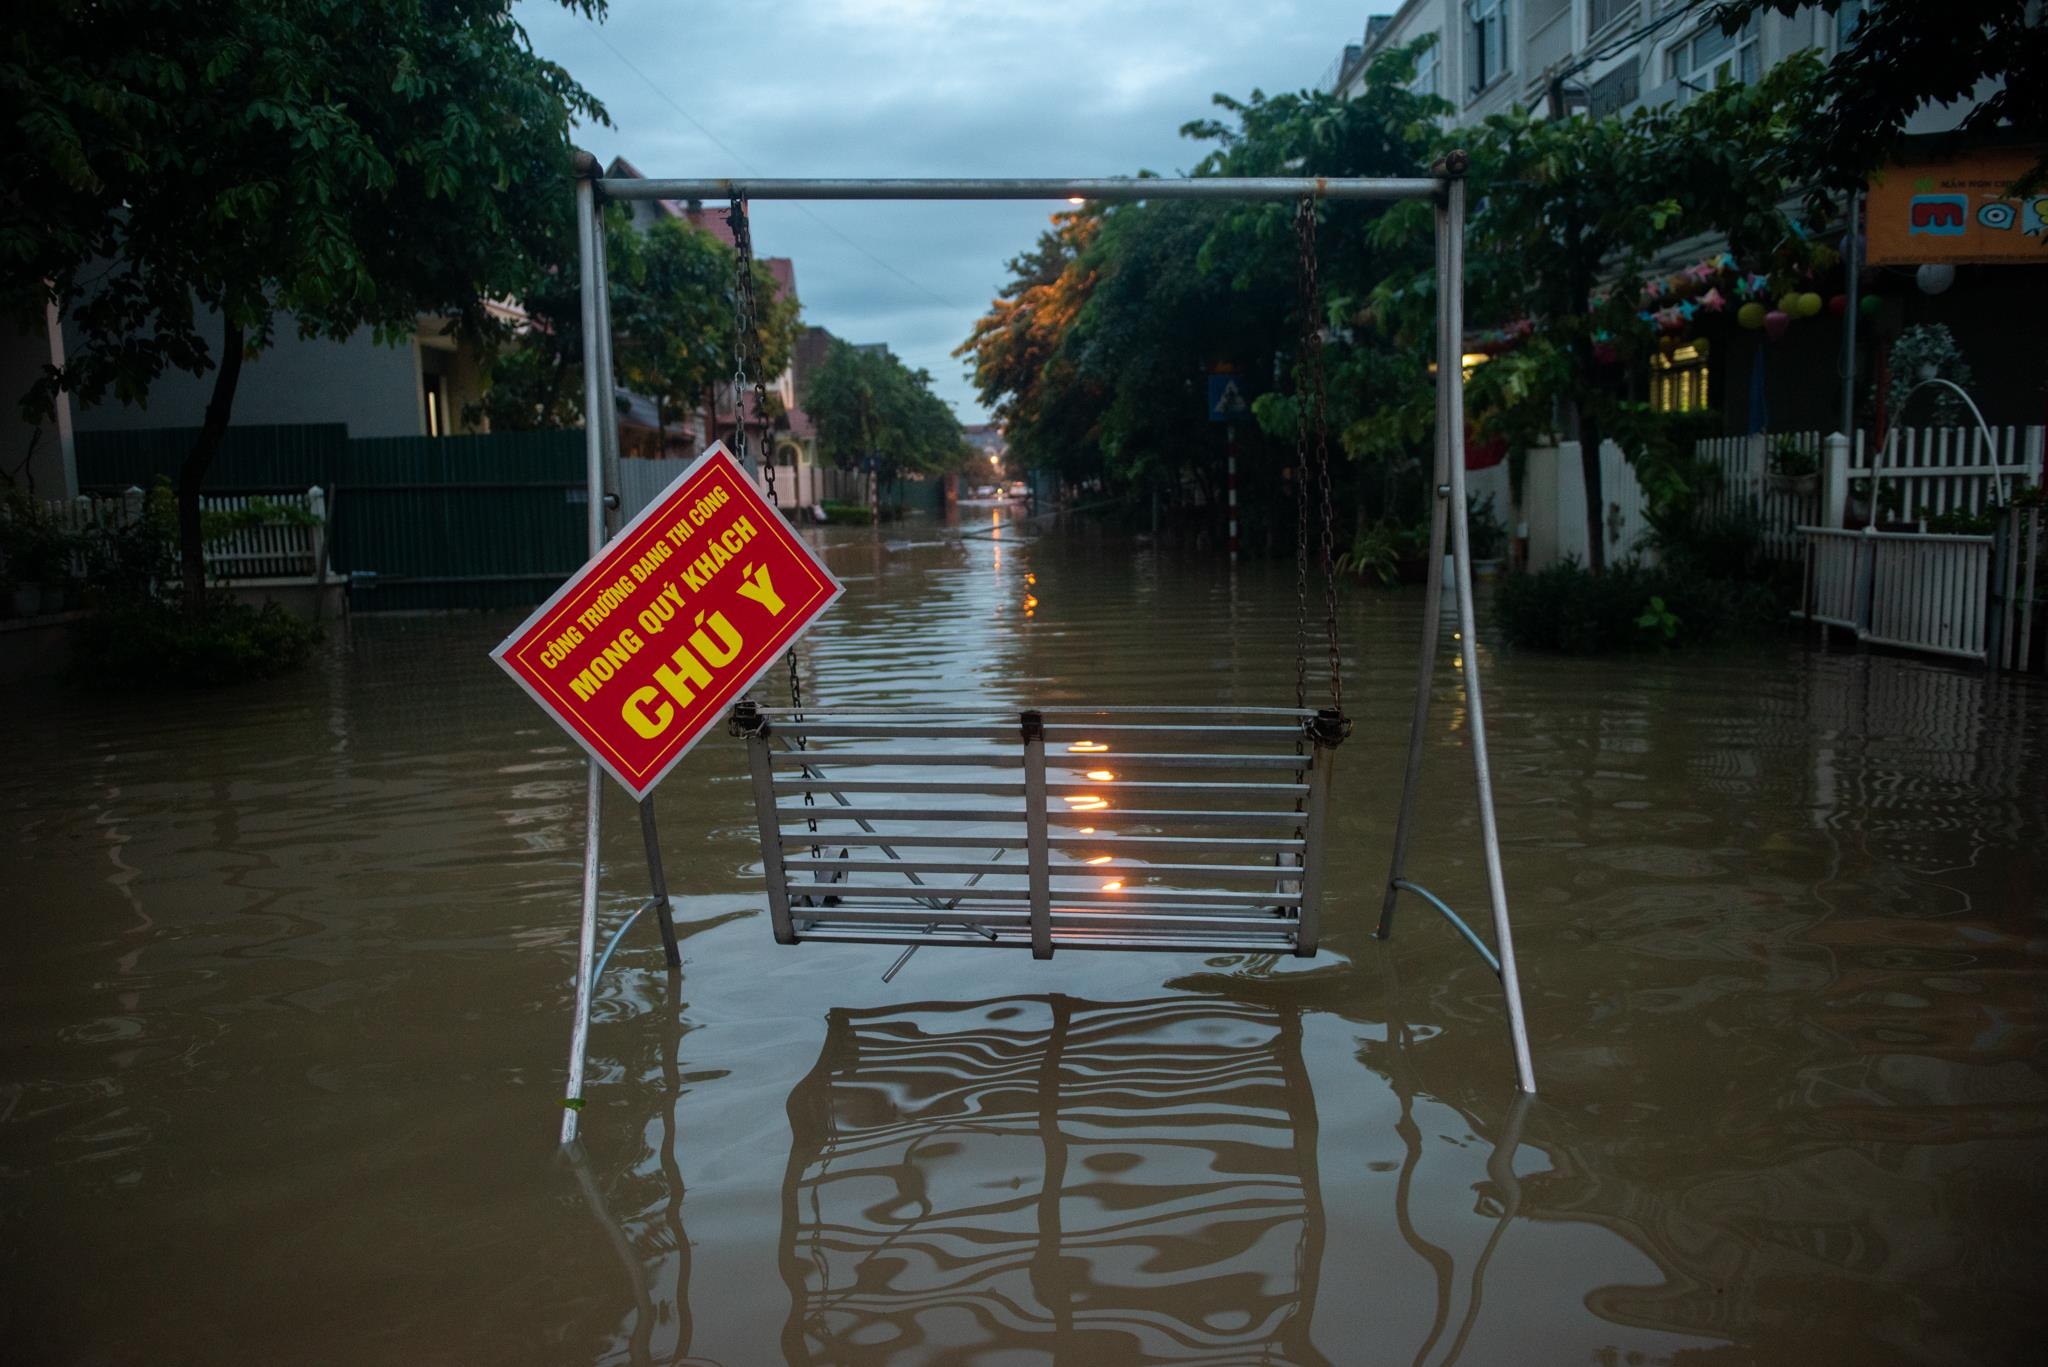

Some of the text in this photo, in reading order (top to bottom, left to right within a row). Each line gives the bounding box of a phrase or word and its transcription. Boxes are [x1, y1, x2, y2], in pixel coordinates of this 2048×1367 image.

[539, 485, 731, 670] CÔNG TRƯỜNG ĐANG THI CÔNG
[568, 515, 758, 703] MONG QUÝ KHÁCH
[621, 561, 786, 740] CHÚ Ý
